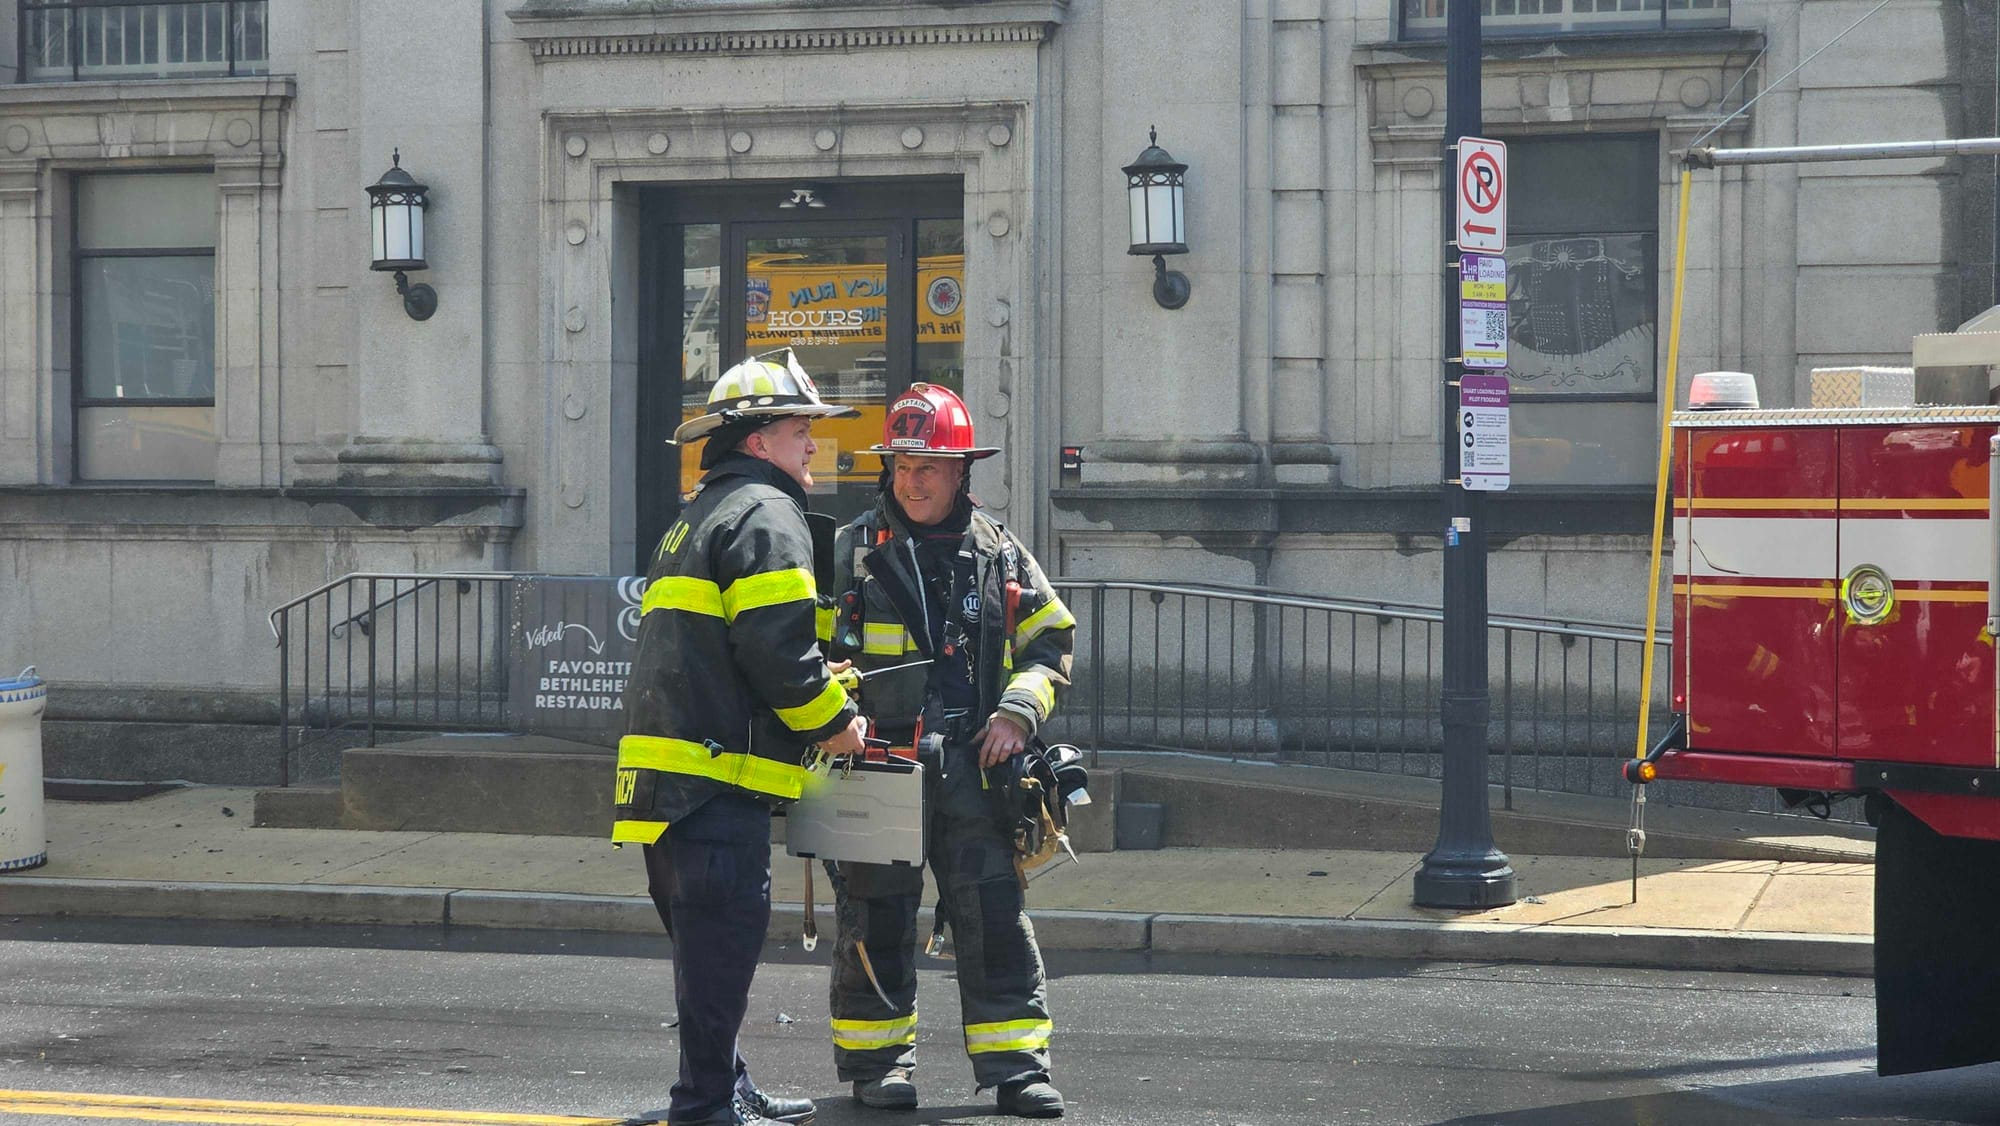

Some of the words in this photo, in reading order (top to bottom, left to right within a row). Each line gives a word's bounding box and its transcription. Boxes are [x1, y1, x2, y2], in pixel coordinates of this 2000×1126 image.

[1476, 165, 1493, 204] P
[1479, 259, 1494, 268] PAID
[1479, 270, 1505, 279] LOADING
[768, 309, 863, 327] HOURS
[828, 336, 840, 345] ST
[897, 399, 926, 409] CAPTAIN
[891, 413, 927, 437] 47
[892, 439, 924, 447] ALLENTOWN
[967, 597, 980, 610] 10
[526, 621, 566, 650] Voted
[540, 677, 628, 693] BETHLEHE
